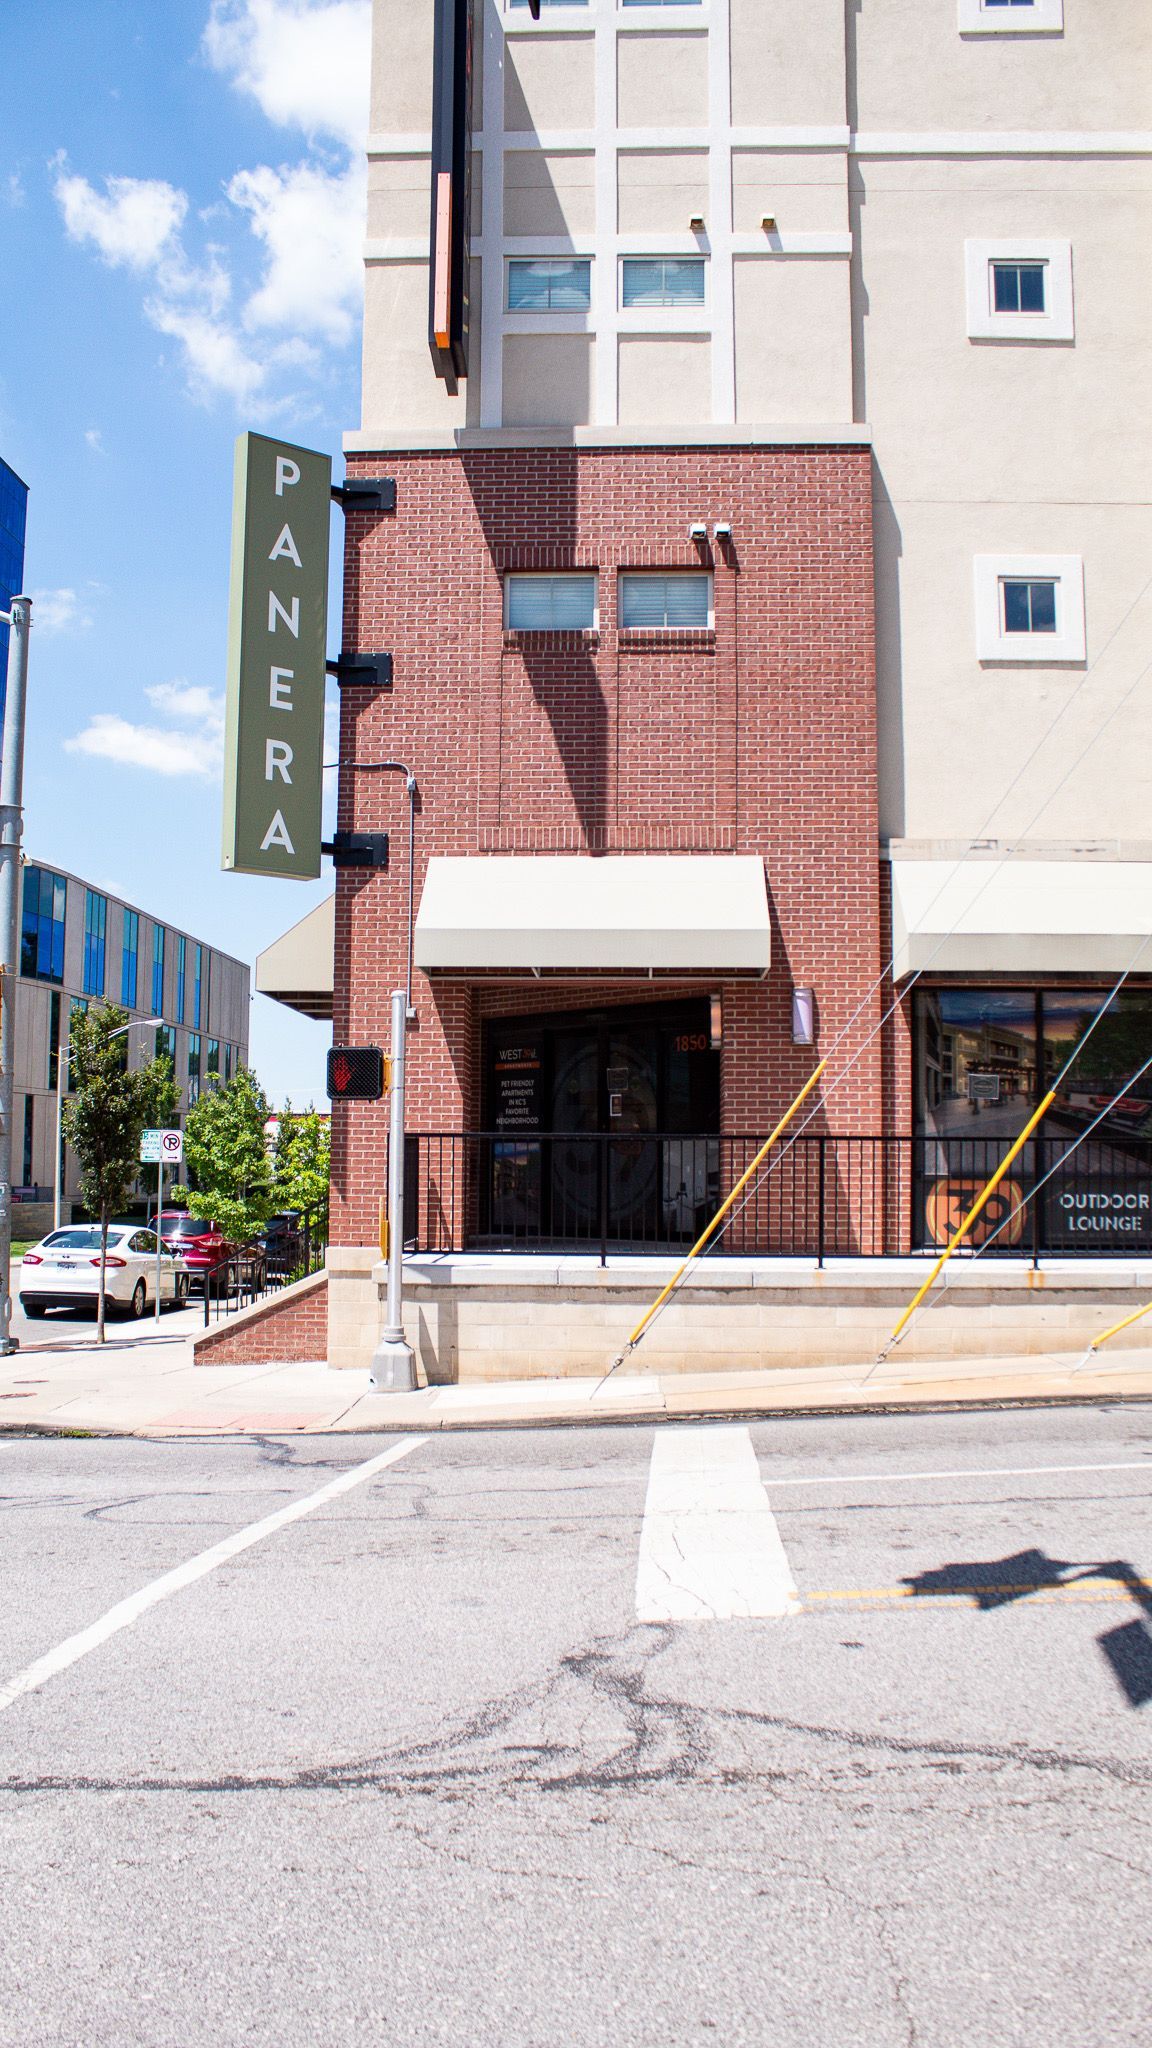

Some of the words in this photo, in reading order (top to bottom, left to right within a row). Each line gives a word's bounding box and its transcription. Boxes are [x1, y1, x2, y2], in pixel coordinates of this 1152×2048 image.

[260, 455, 303, 855] PANERA
[675, 1034, 707, 1052] 1850
[499, 1048, 523, 1060] WEST
[501, 1080, 510, 1088] PET
[510, 1079, 535, 1087] FRIENDLY
[501, 1089, 534, 1097] APARTMENTS
[505, 1107, 529, 1115] FAVORITE
[495, 1117, 539, 1125] NEIGHBORHOOD
[1060, 1193, 1150, 1209] OUTDOOR
[1068, 1216, 1142, 1231] LOUNGE
